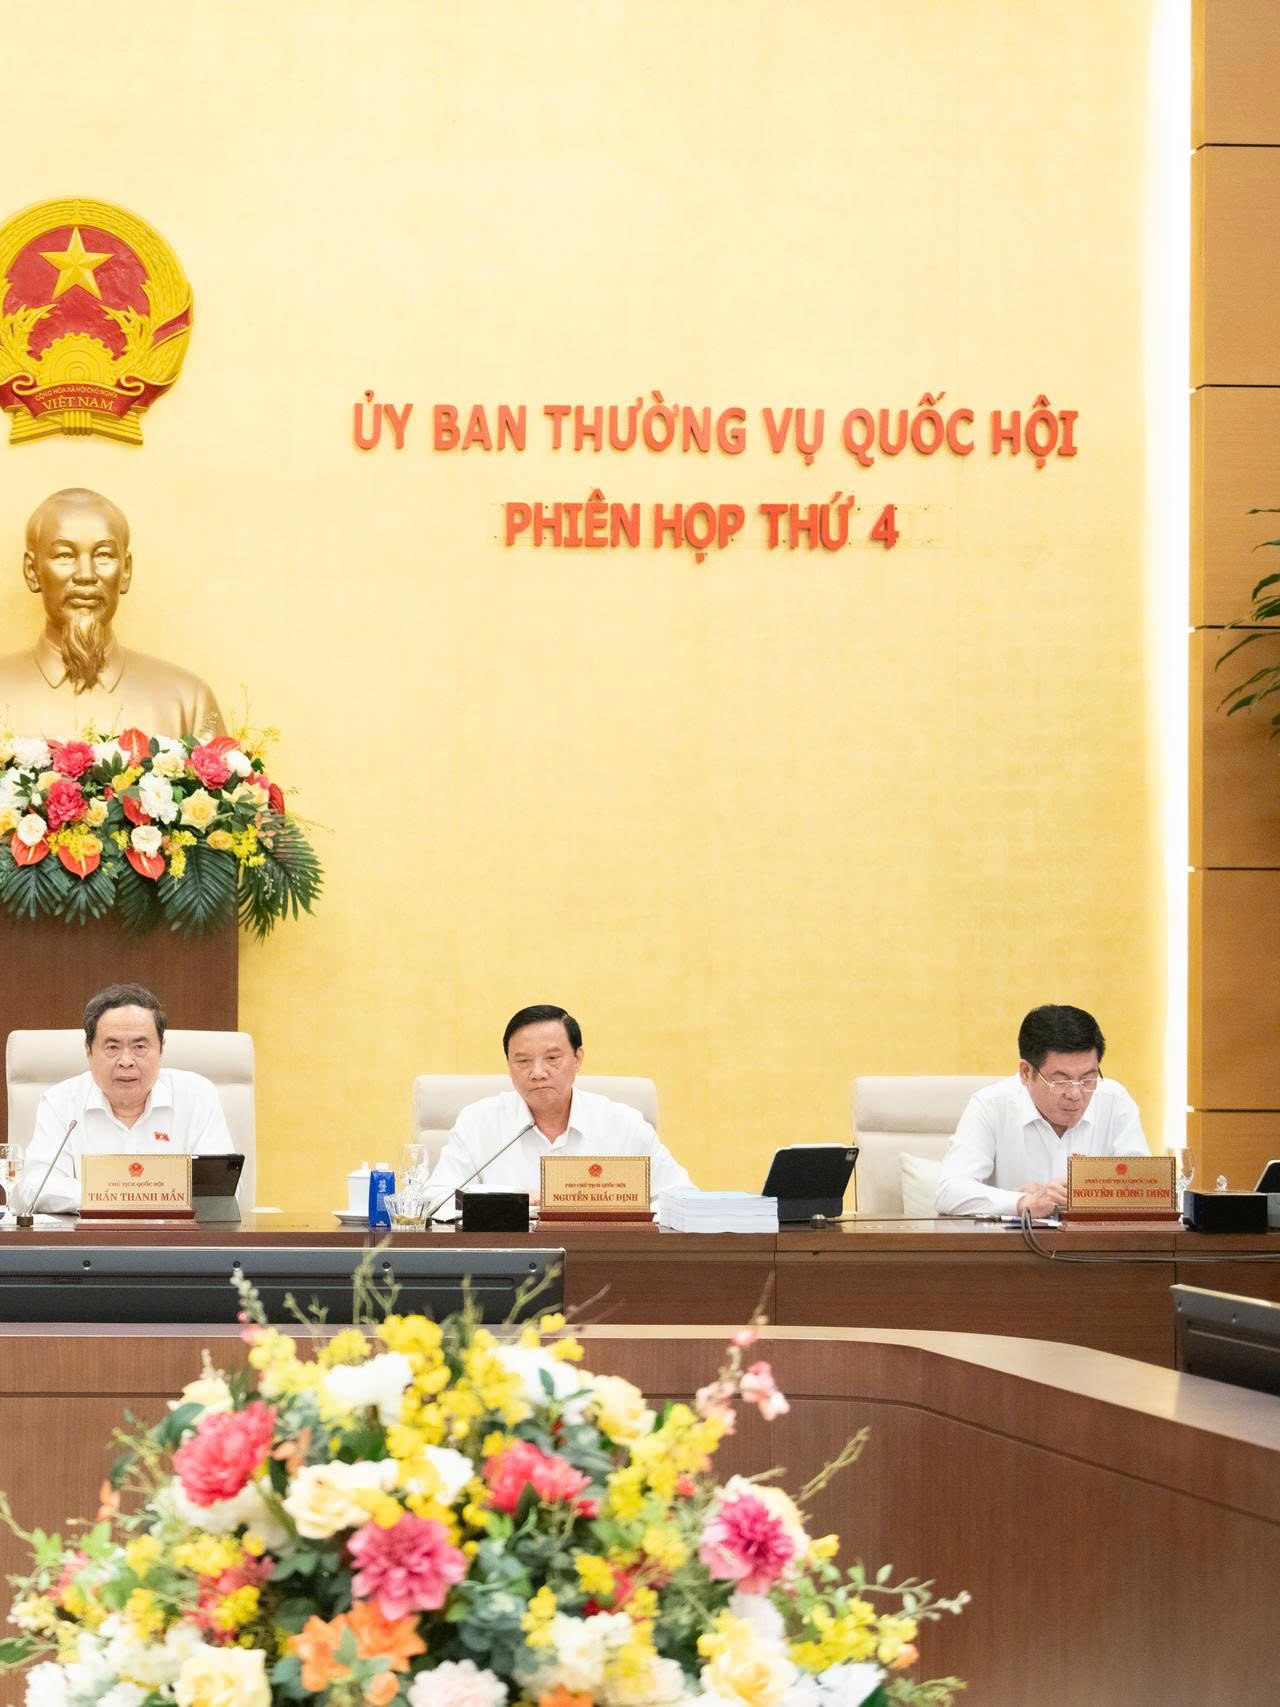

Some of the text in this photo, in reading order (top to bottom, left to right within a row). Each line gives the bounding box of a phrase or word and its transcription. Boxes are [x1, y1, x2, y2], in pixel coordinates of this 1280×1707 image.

[77, 396, 113, 410] NAM
[353, 389, 1078, 468] ỦY BAN THƯỜNG VỤ QUỐC HỘI
[505, 488, 900, 564] PHIÊN HỌP THỨ 4
[120, 1192, 158, 1201] THANH
[590, 1190, 615, 1201] KHẮC
[616, 1193, 638, 1203] ĐỊNH
